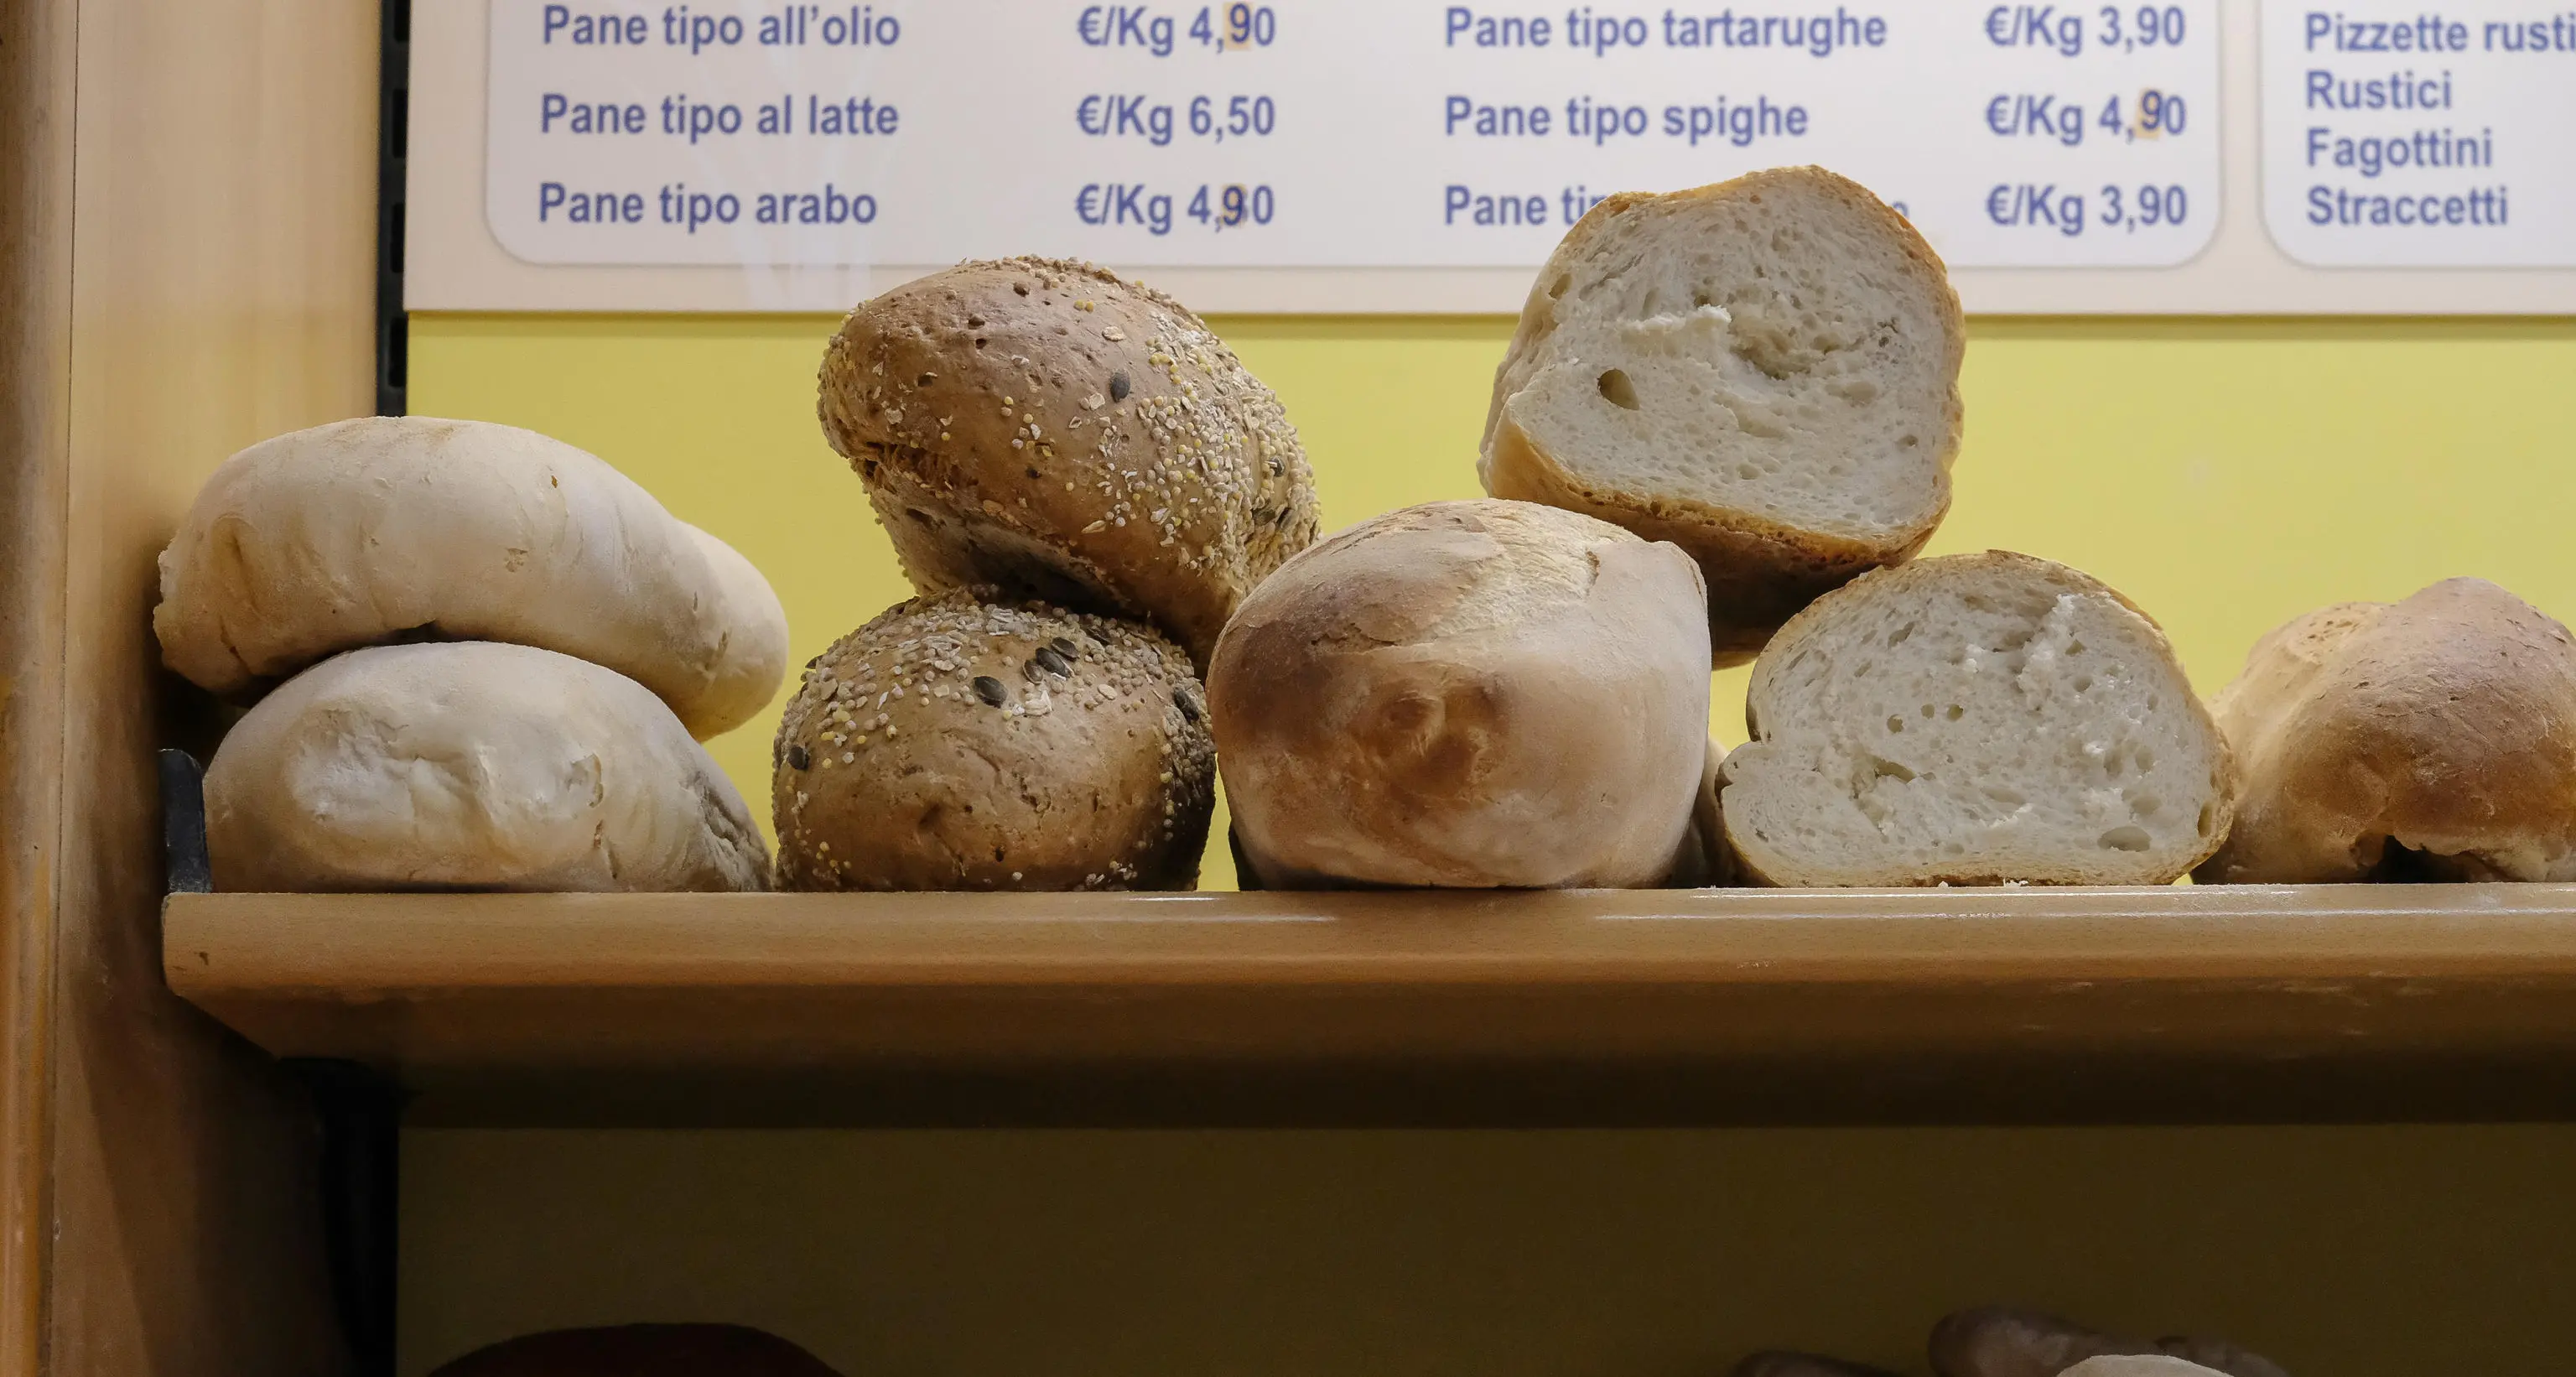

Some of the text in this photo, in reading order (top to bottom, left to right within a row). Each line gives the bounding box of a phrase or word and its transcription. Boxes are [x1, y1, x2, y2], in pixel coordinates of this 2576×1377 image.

[545, 6, 901, 54] Pane tipo all’olio
[1078, 3, 1275, 57] €/Kg 4,90
[1446, 8, 1887, 57] Pane tipo tartarughe
[1986, 6, 2185, 58] €/Kg 3,90
[2306, 12, 2469, 52] Pizzette
[2306, 70, 2451, 110] Rustici
[543, 95, 898, 143] Pane tipo al latte
[1078, 95, 1275, 145] €/Kg 6,50
[1446, 96, 1809, 147] Pane tipo spighe
[1986, 89, 2186, 145] €/Kg 4,90
[2307, 127, 2493, 179] Fagottini
[540, 184, 876, 232] Pane tipo arabo
[1076, 184, 1274, 236] €/Kg 4,90
[1446, 184, 1608, 226] Pane ti
[1986, 184, 2188, 236] €/Kg 3,90
[2307, 185, 2508, 226] Straccetti
